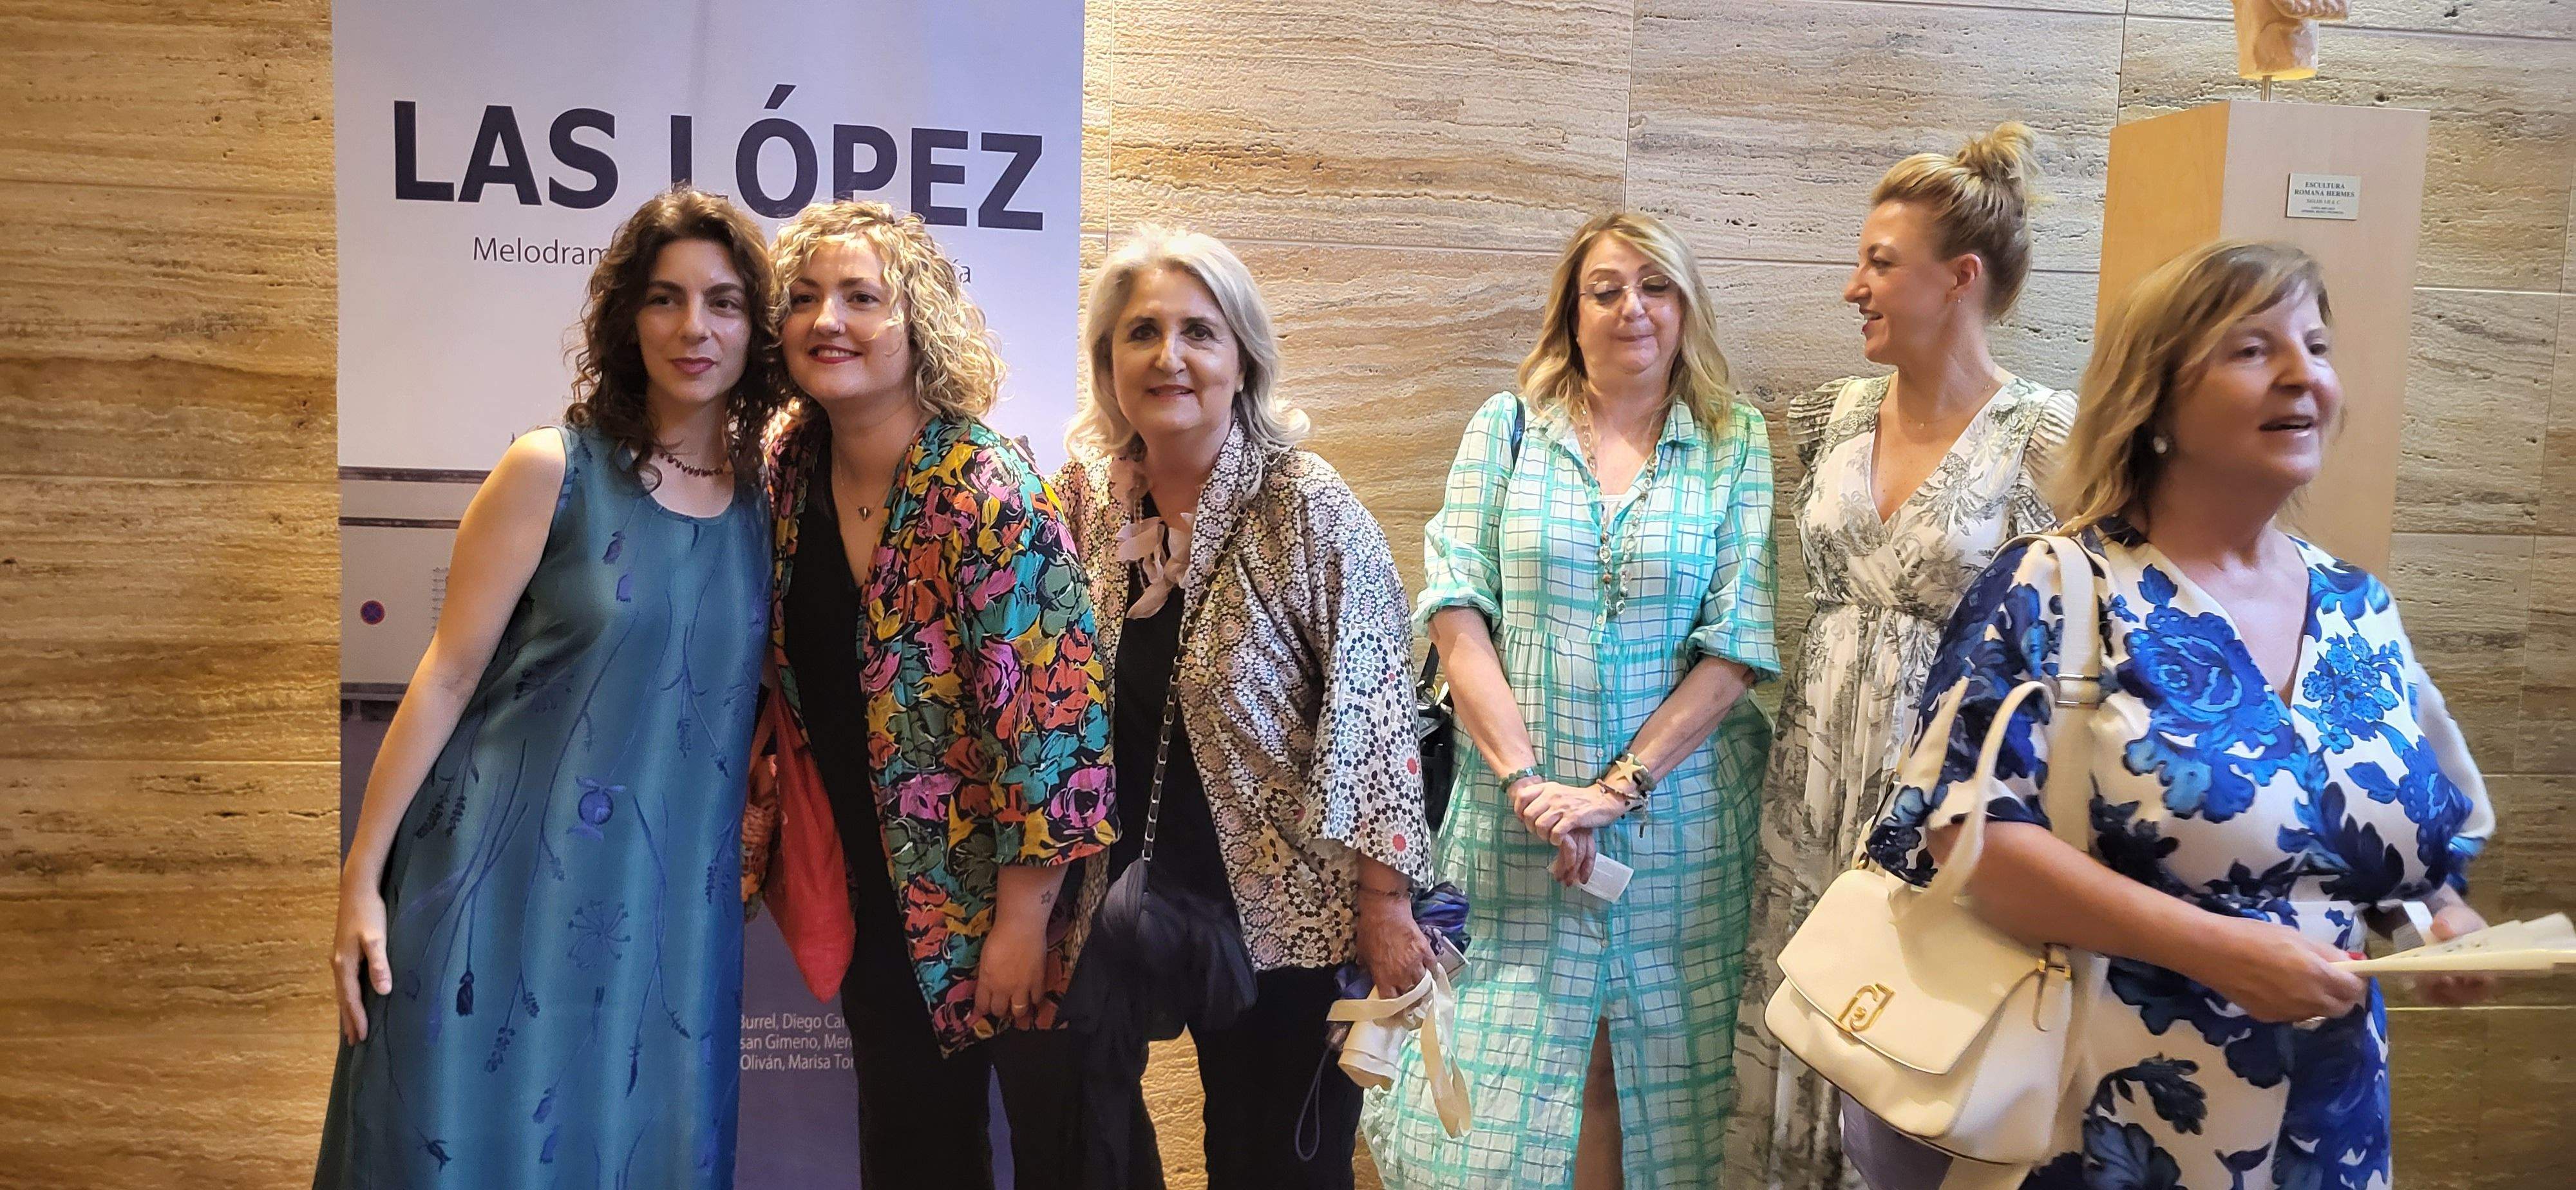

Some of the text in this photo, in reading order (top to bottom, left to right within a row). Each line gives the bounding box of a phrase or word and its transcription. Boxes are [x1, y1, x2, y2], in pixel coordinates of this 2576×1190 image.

[394, 84, 1043, 231] LAS LÓPEZ
[765, 1034, 820, 1051] Gimeno,
[741, 1053, 785, 1072] Oliván,
[788, 1053, 831, 1069] Marisa
